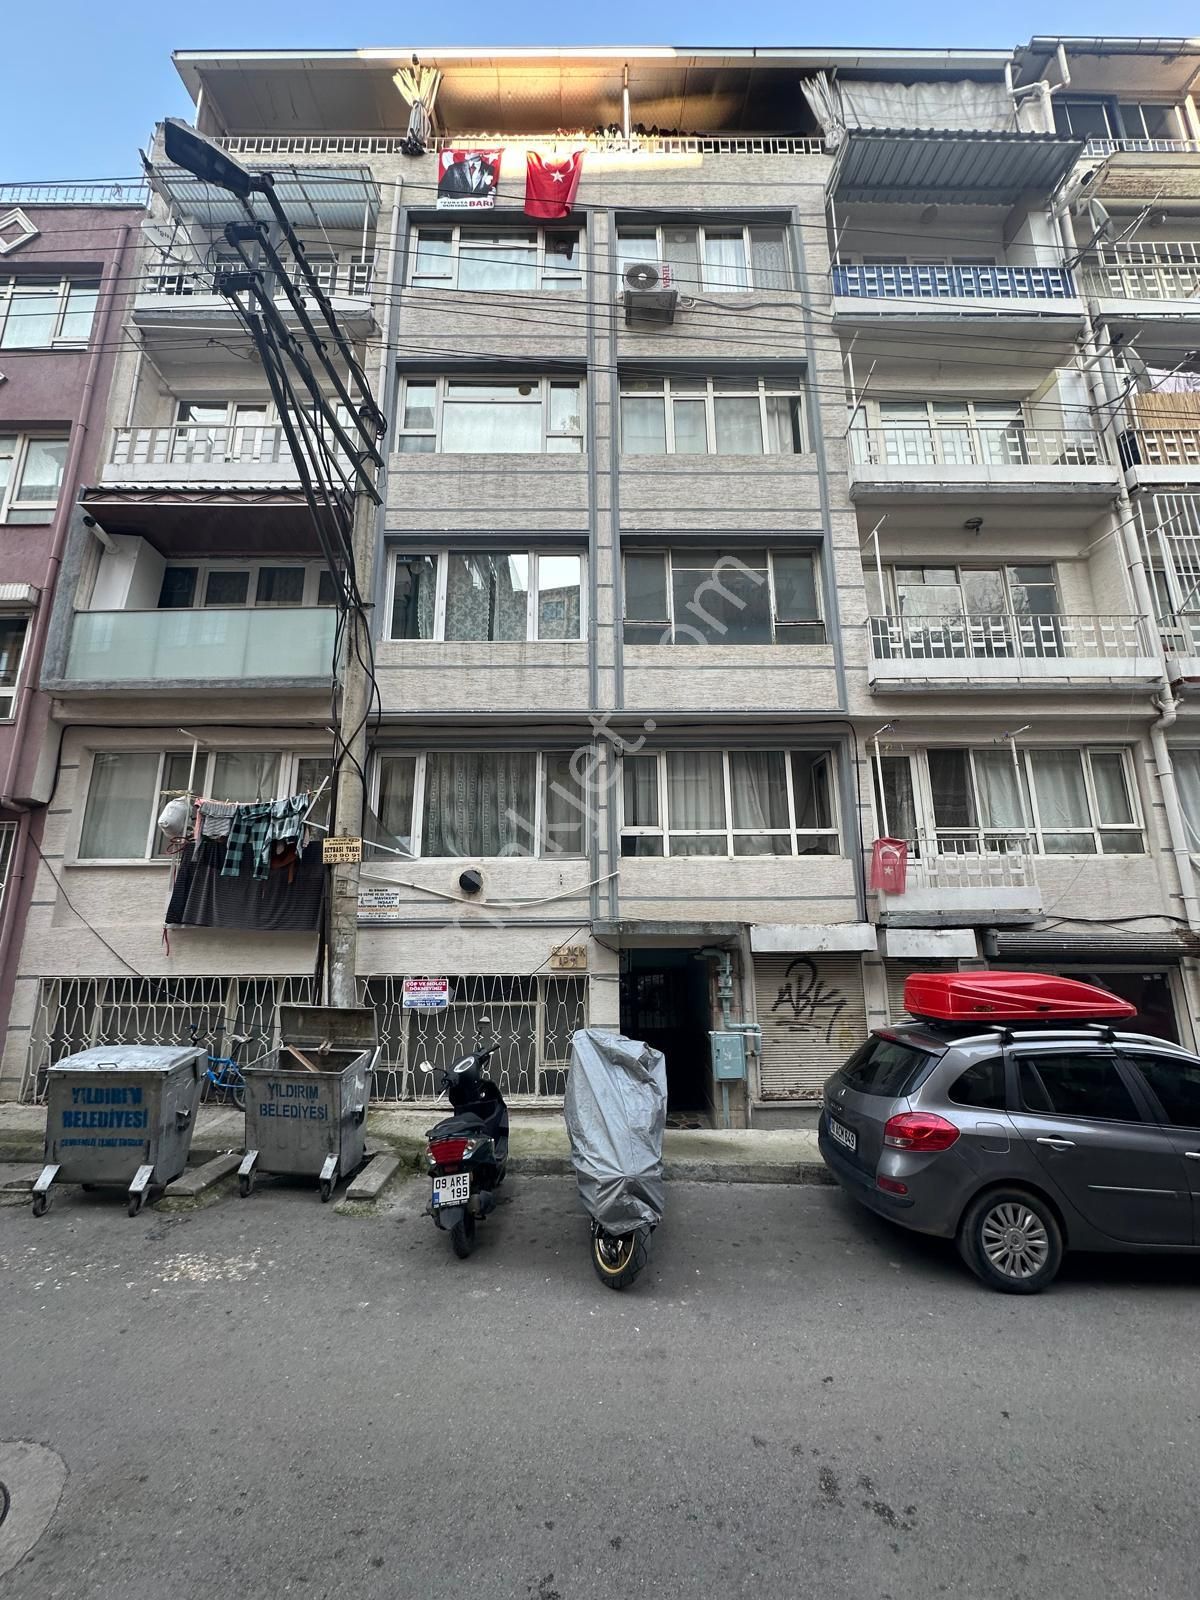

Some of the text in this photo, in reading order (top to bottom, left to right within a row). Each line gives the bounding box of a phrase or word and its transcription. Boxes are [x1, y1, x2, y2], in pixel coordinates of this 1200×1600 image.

[267, 1083, 319, 1100] YILDIRIM
[260, 1103, 329, 1121] BELEDİYESİ
[435, 1176, 468, 1189] 09 ARE
[451, 1187, 468, 1198] 199
